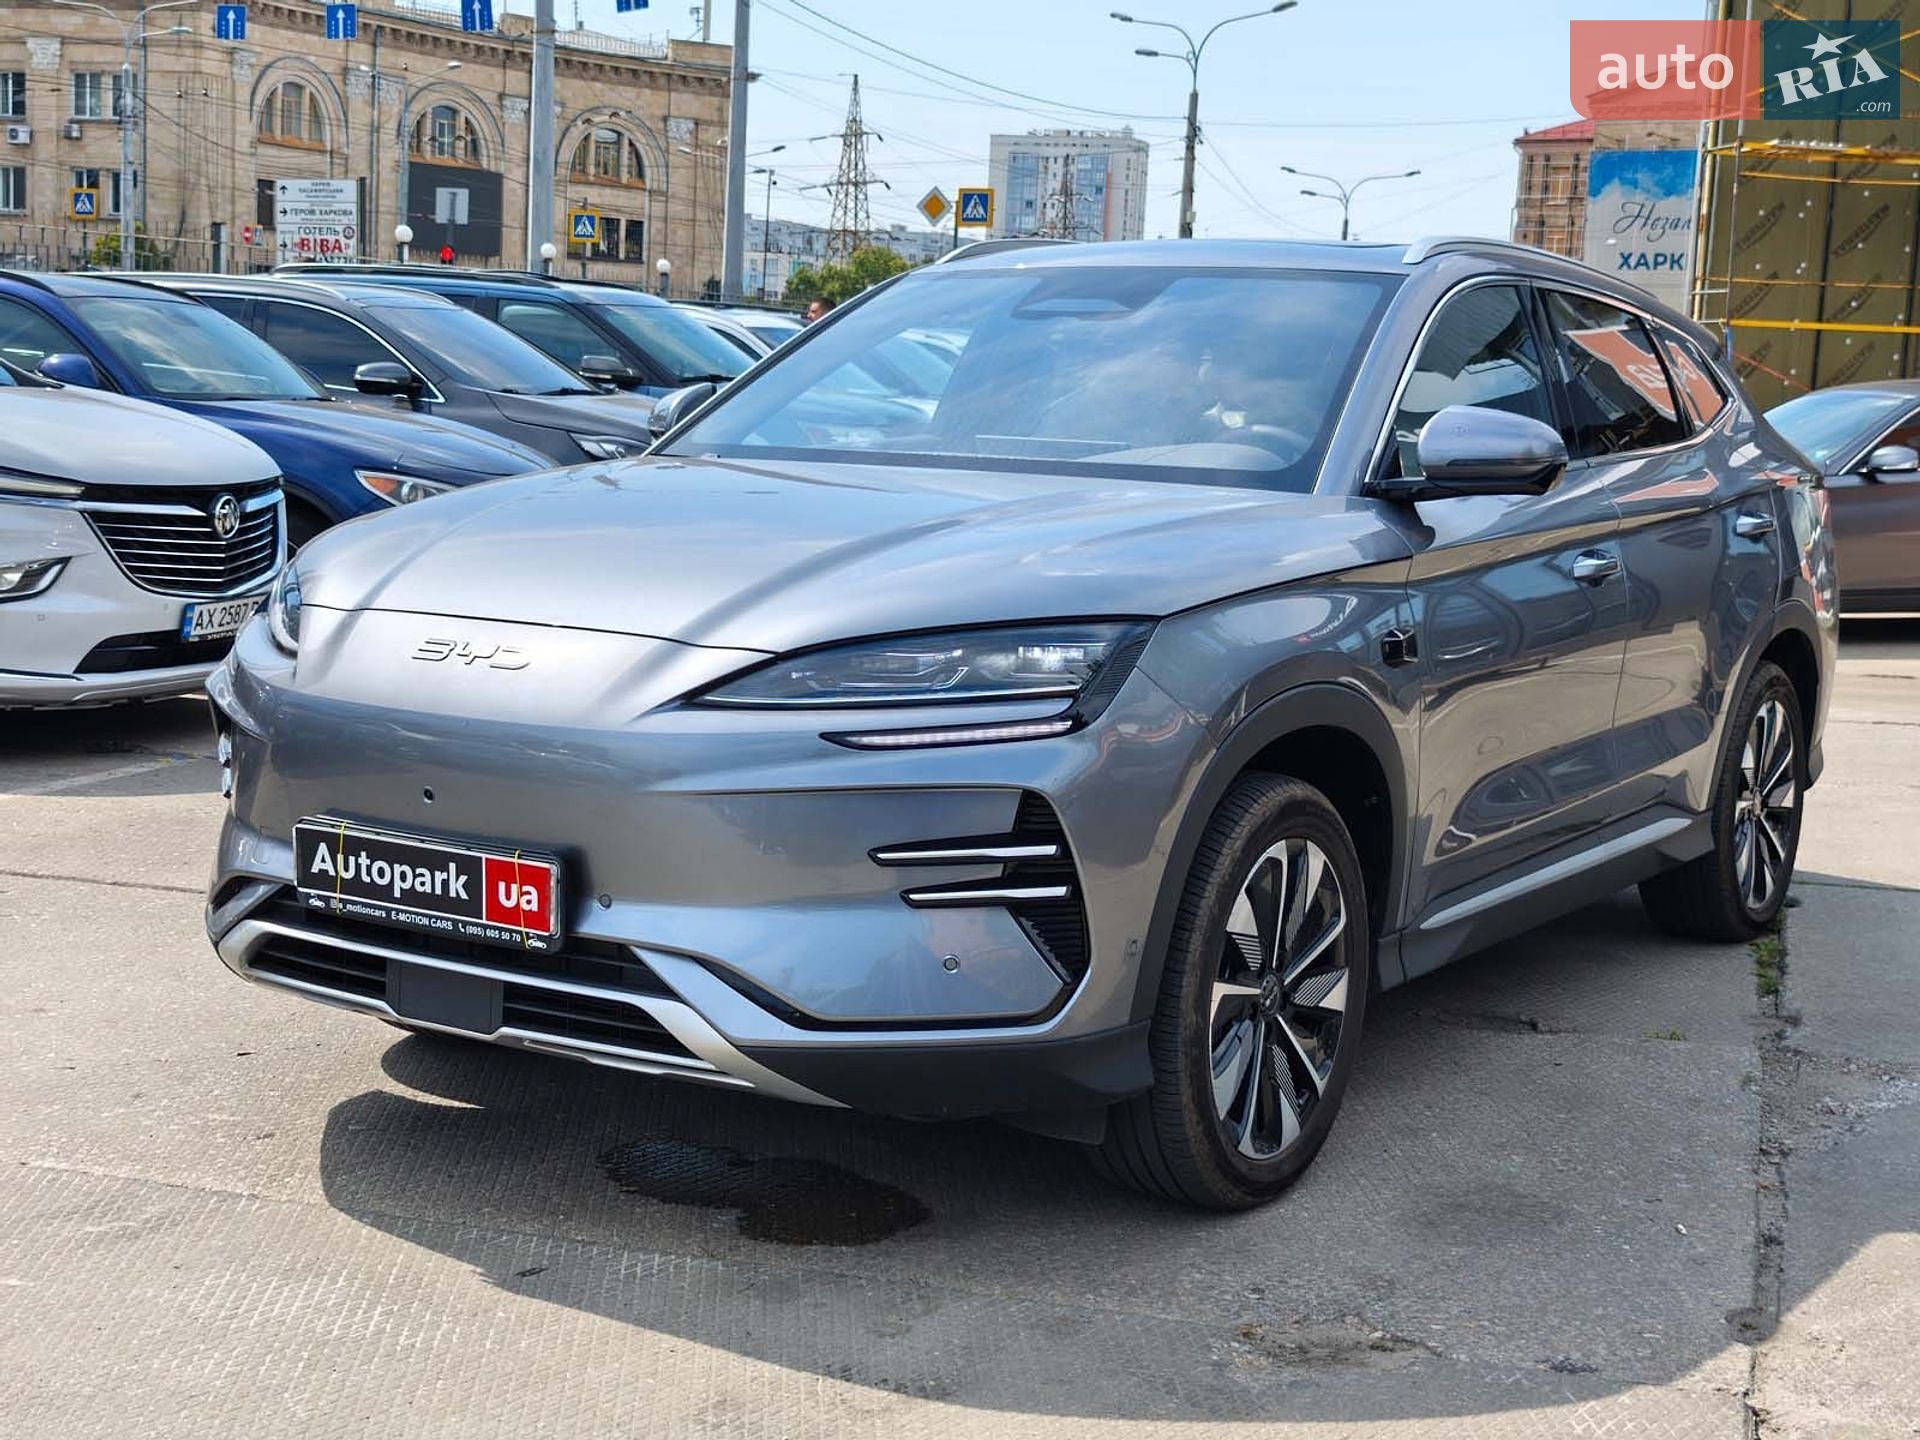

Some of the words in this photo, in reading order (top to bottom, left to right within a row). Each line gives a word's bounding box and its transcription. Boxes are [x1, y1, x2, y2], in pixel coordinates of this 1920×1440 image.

[320, 208, 353, 216] ХАРКОВА
[297, 226, 340, 236] ГОТЕЛЬ
[193, 608, 217, 632] AX
[217, 602, 250, 628] 2587
[410, 638, 531, 671] BYD
[310, 842, 470, 900] Autopark
[498, 881, 538, 912] ua
[391, 910, 430, 926] E-MOTION
[430, 919, 453, 930] CARS
[512, 933, 521, 942] 70
